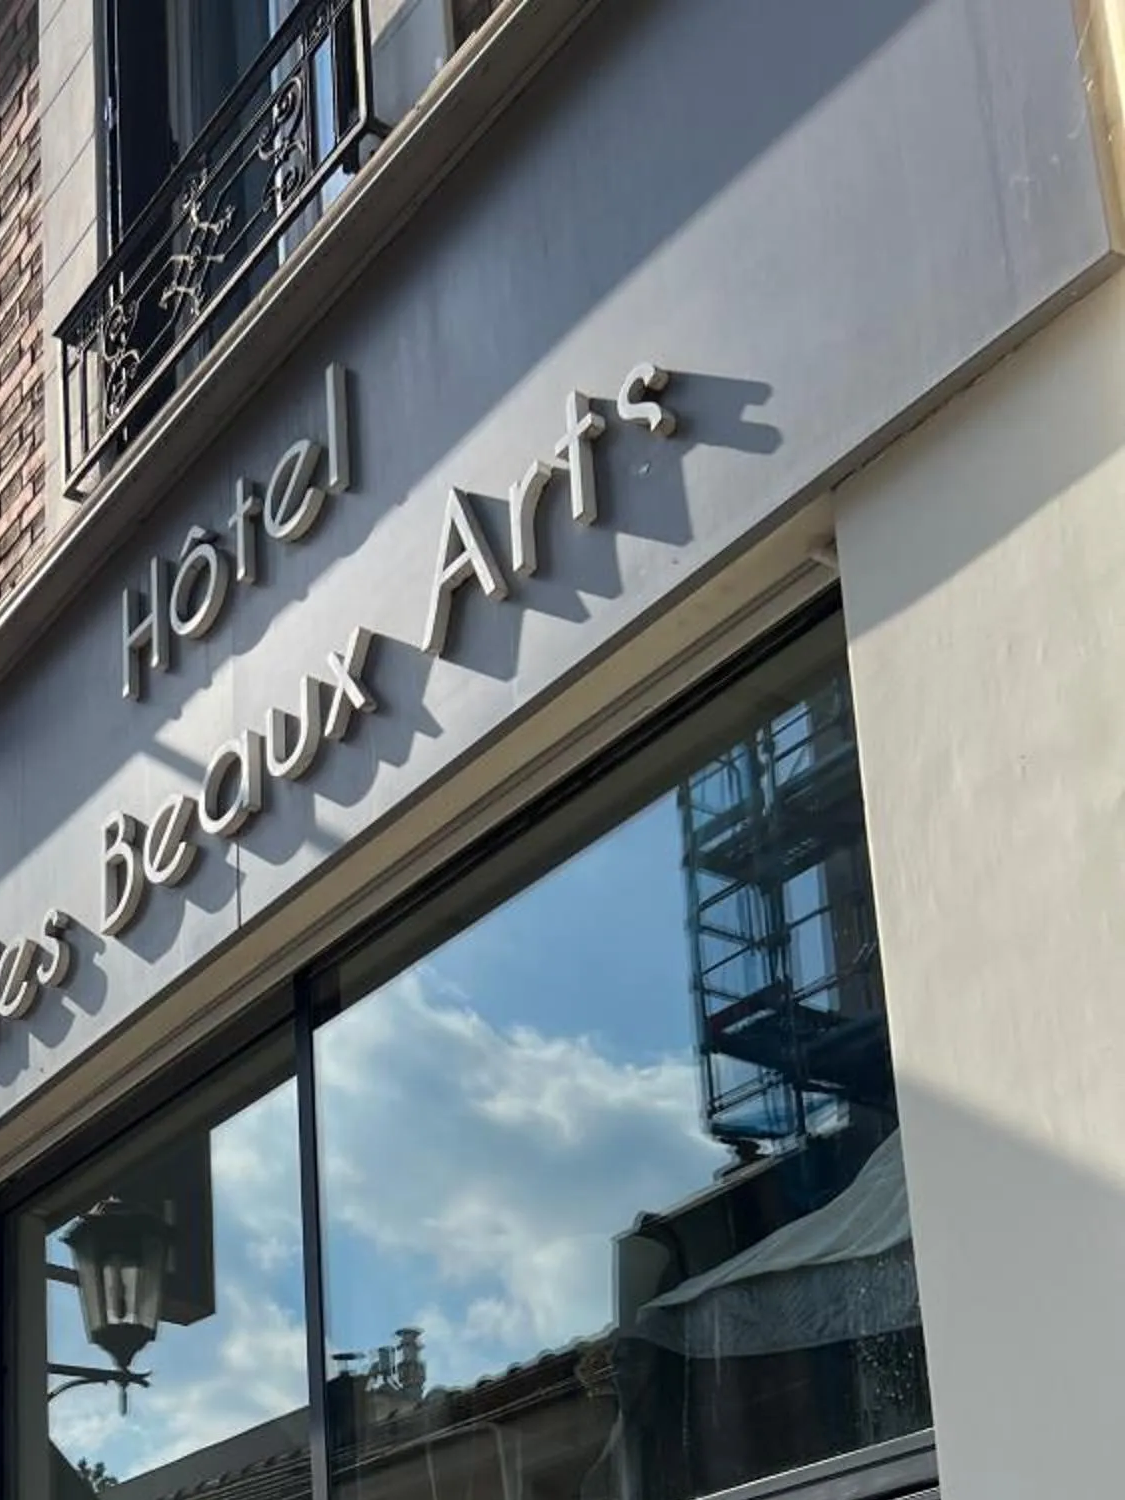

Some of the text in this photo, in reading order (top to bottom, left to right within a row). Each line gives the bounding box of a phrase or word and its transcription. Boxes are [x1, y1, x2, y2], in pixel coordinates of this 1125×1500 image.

[99, 626, 378, 937] Beaux
[421, 361, 674, 657] Arts
[120, 361, 351, 702] Hôtel
